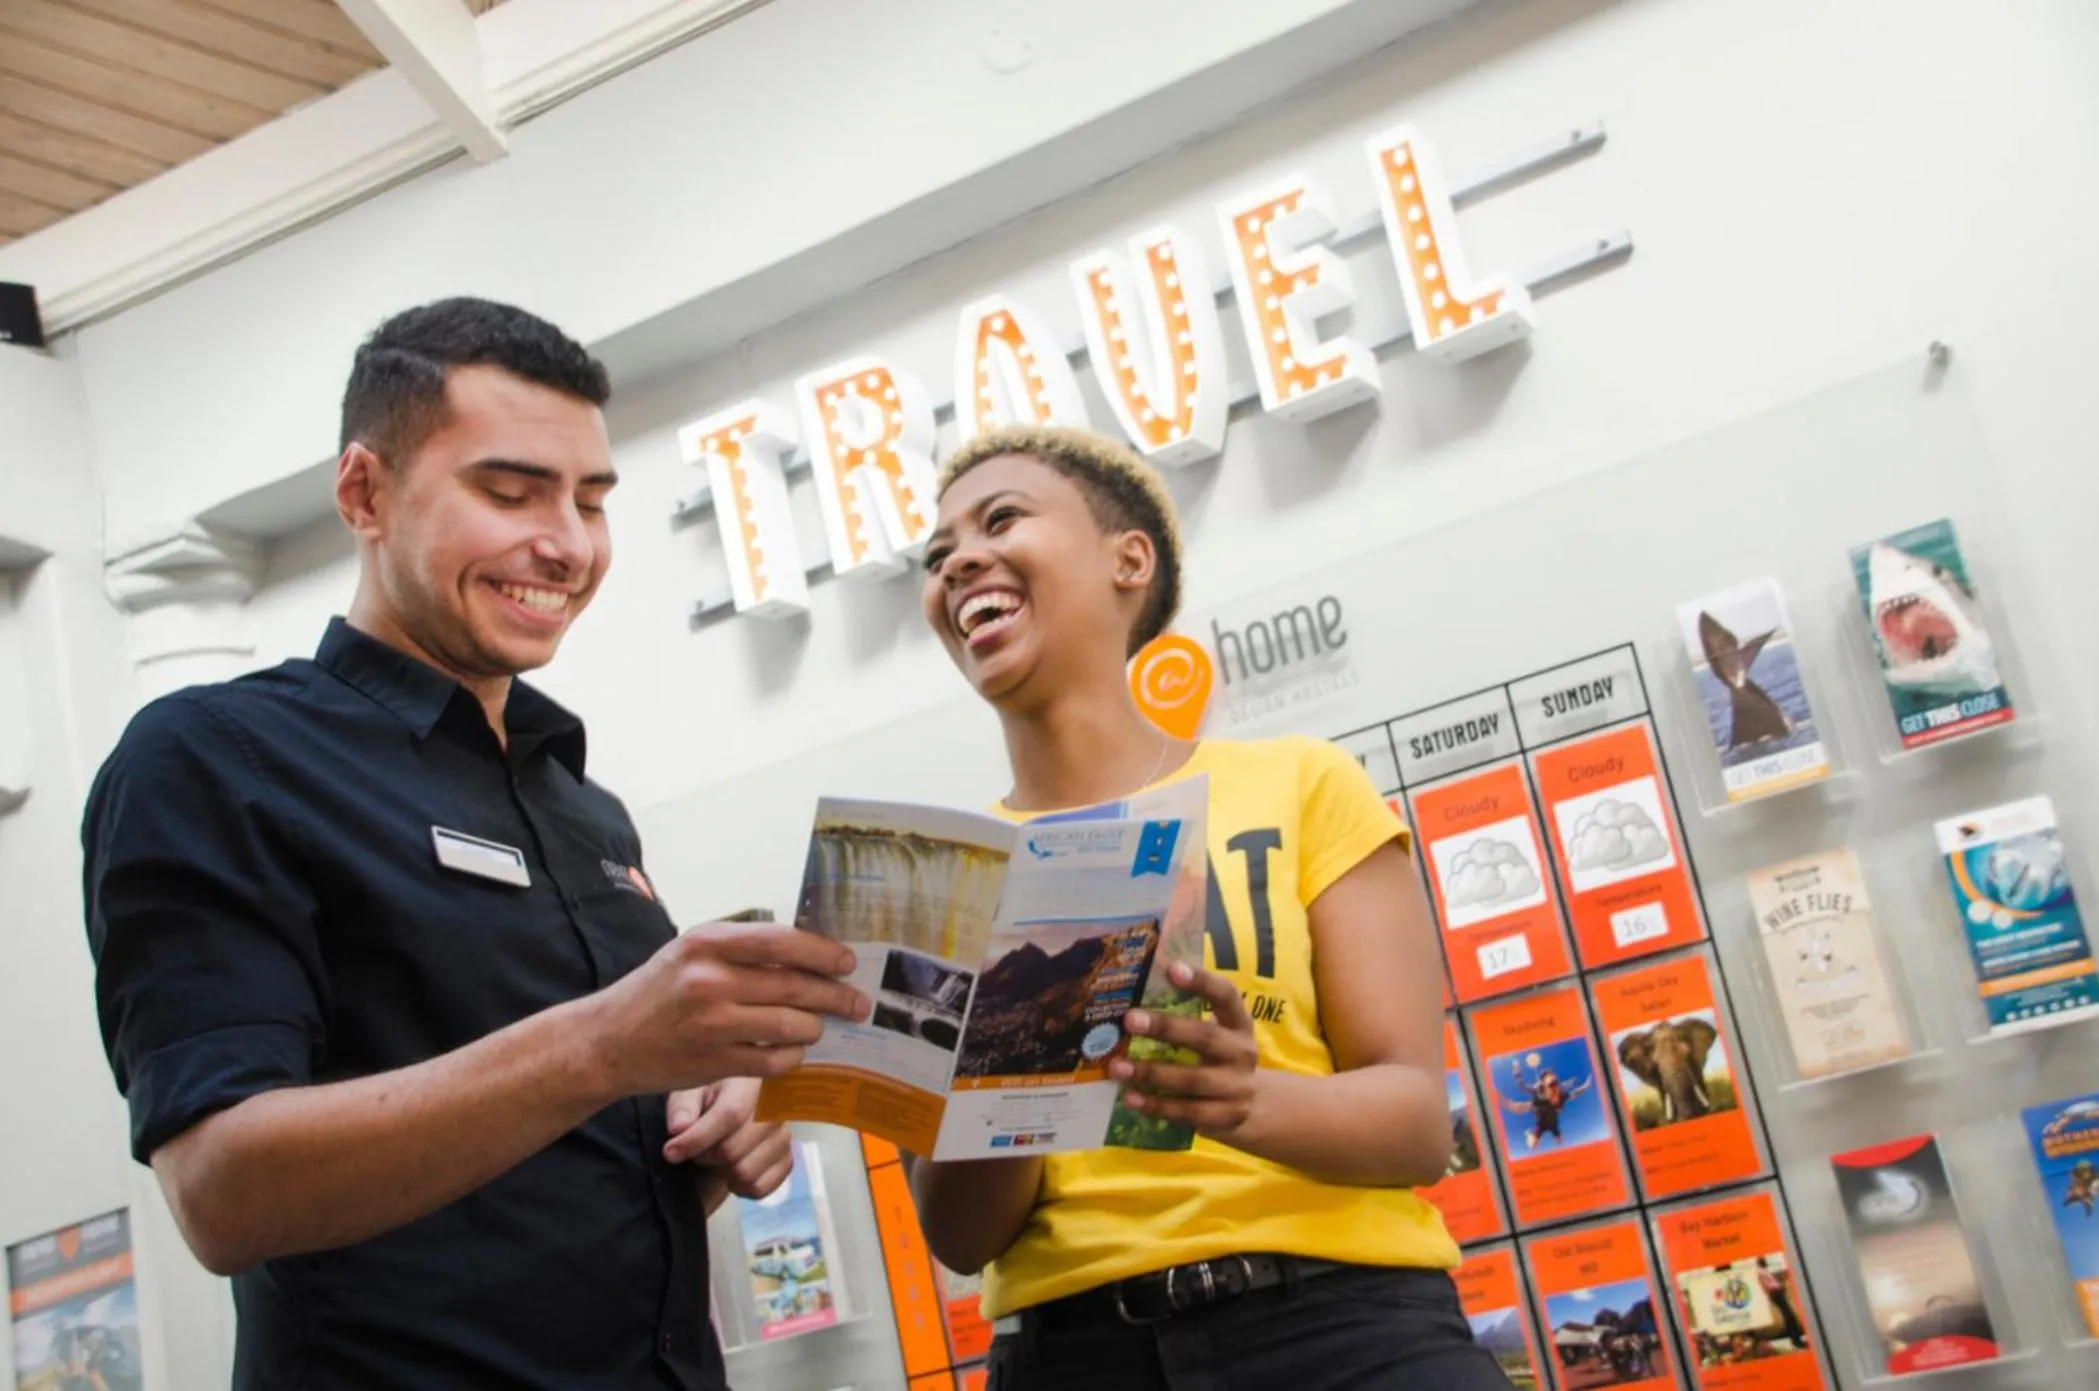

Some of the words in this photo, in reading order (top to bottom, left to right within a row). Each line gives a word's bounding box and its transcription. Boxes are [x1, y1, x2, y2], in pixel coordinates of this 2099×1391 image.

[678, 123, 1535, 620] TRAVEL
[1211, 595, 1347, 685] home
[1541, 676, 1614, 718] SUNDAY
[1901, 713, 1926, 735] GET
[1925, 703, 1960, 727] THIS
[1409, 712, 1500, 760] SATURDAY
[1568, 755, 1626, 783] Cloudy
[1444, 796, 1500, 823] Cloudy
[1762, 898, 1803, 930] WINE
[1807, 892, 1852, 915] FLIES
[1622, 917, 1648, 938] 16
[1487, 949, 1509, 971] 17
[1252, 992, 1285, 1023] ONE
